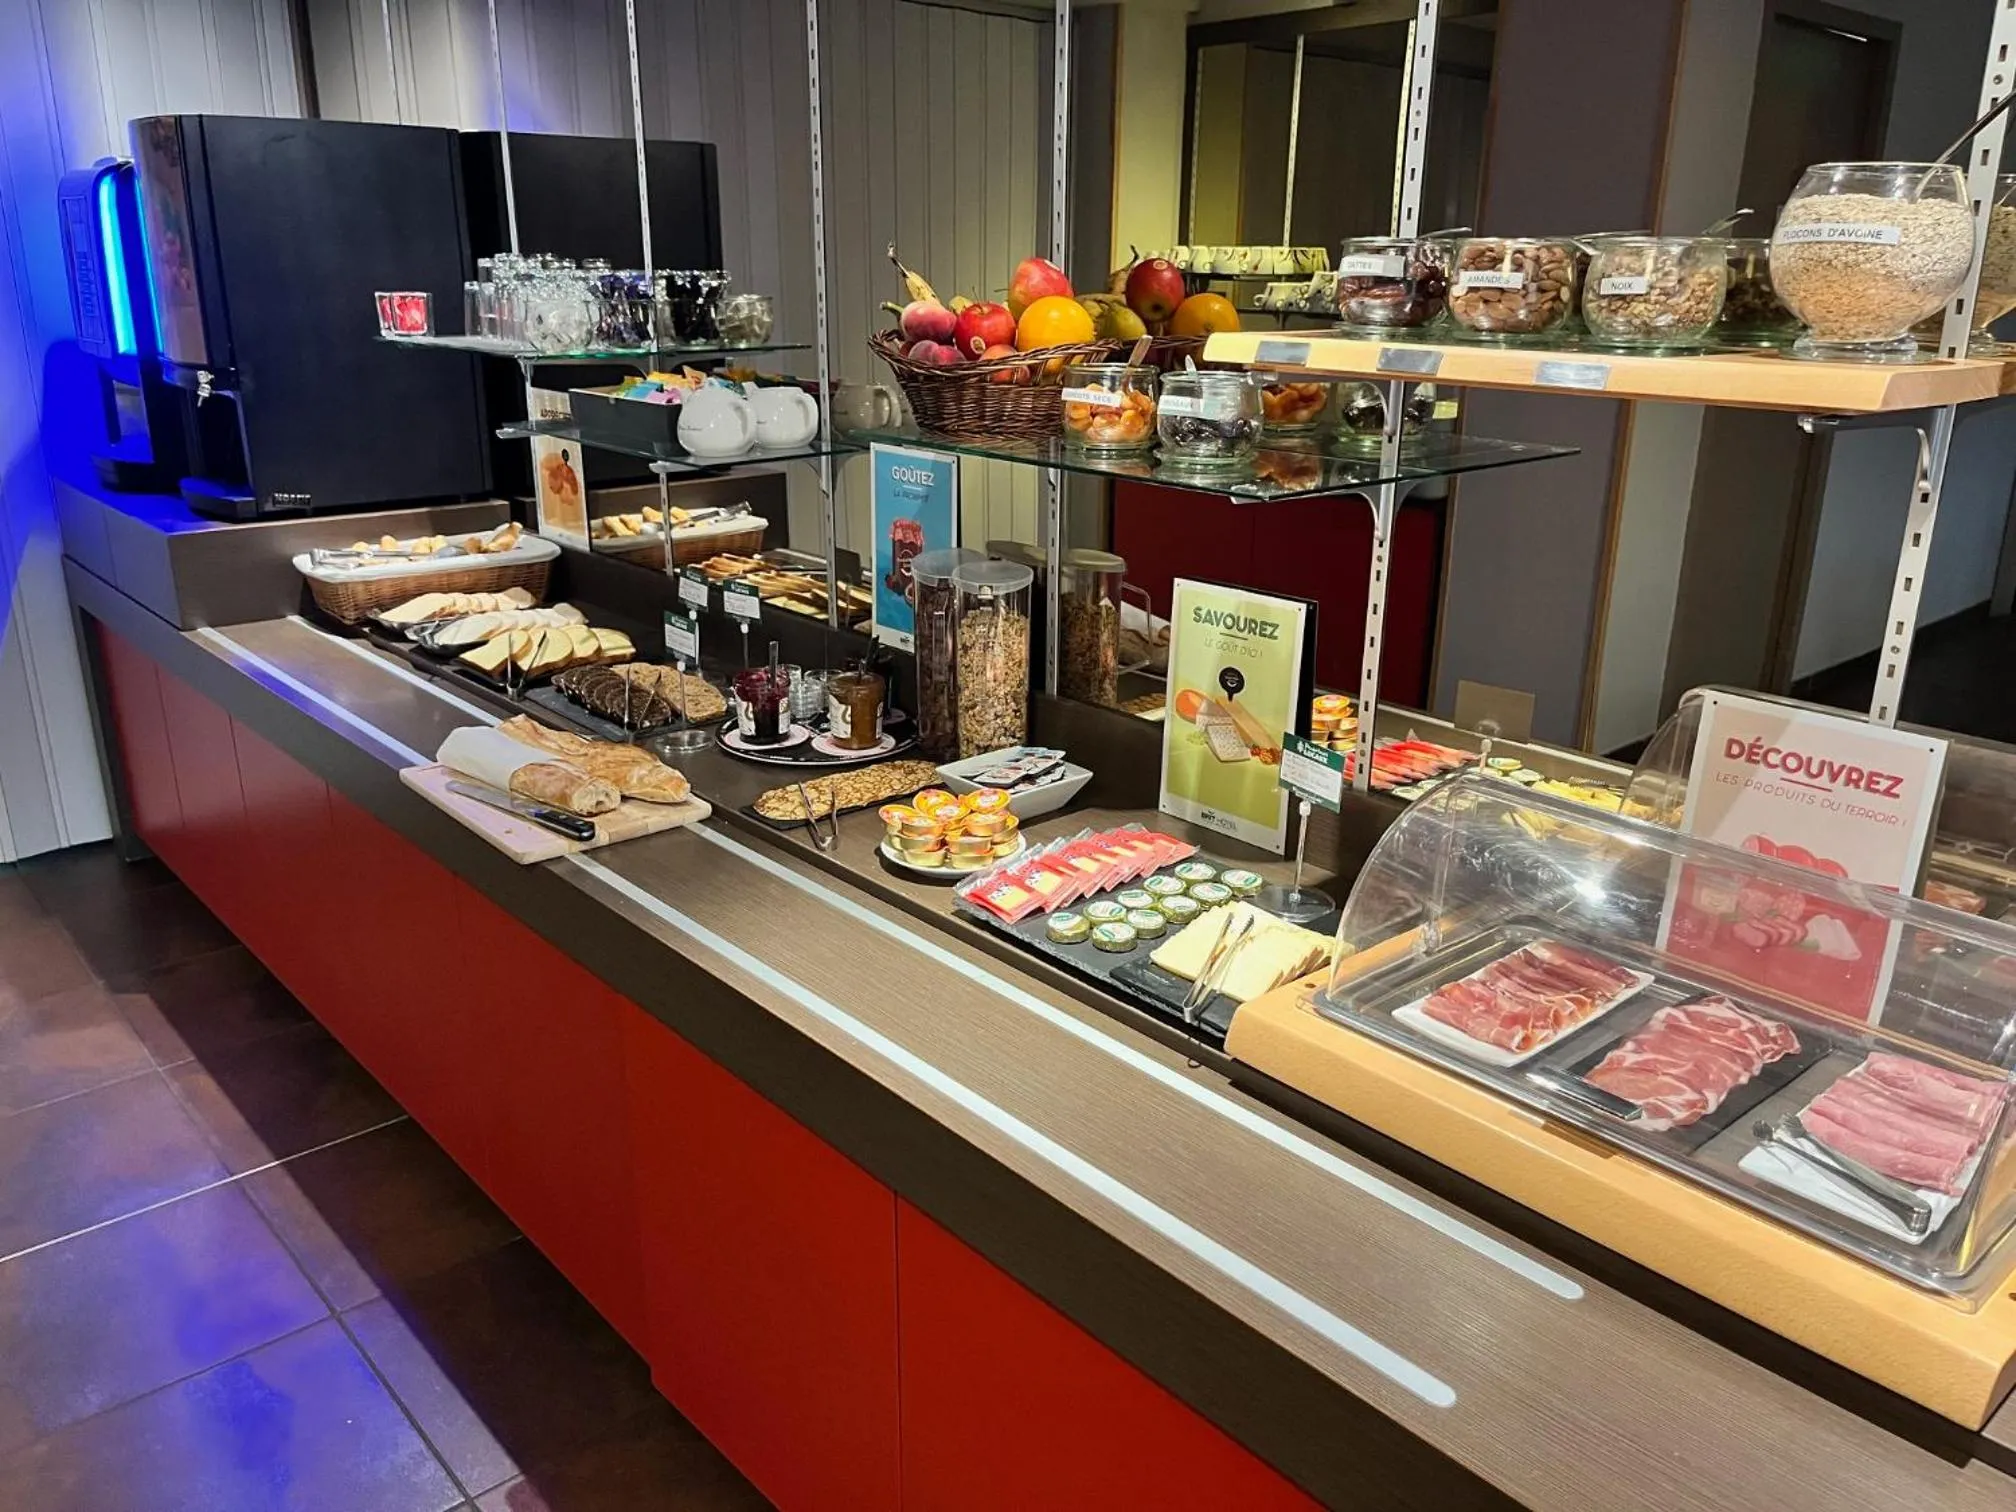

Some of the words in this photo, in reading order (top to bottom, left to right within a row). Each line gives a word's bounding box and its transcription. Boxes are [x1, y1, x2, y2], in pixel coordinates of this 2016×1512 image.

[1827, 227, 1883, 240] D'AVOINE
[1611, 281, 1634, 291] NOIX
[891, 464, 935, 486] GOÛTEZ
[1192, 606, 1280, 641] SAVOUREZ
[1723, 736, 1904, 799] DÉCOUVREZ
[1715, 771, 1739, 786] LES
[1743, 778, 1816, 805] PRODUITS
[1820, 797, 1841, 812] DU
[1845, 804, 1900, 827] TERROIR
